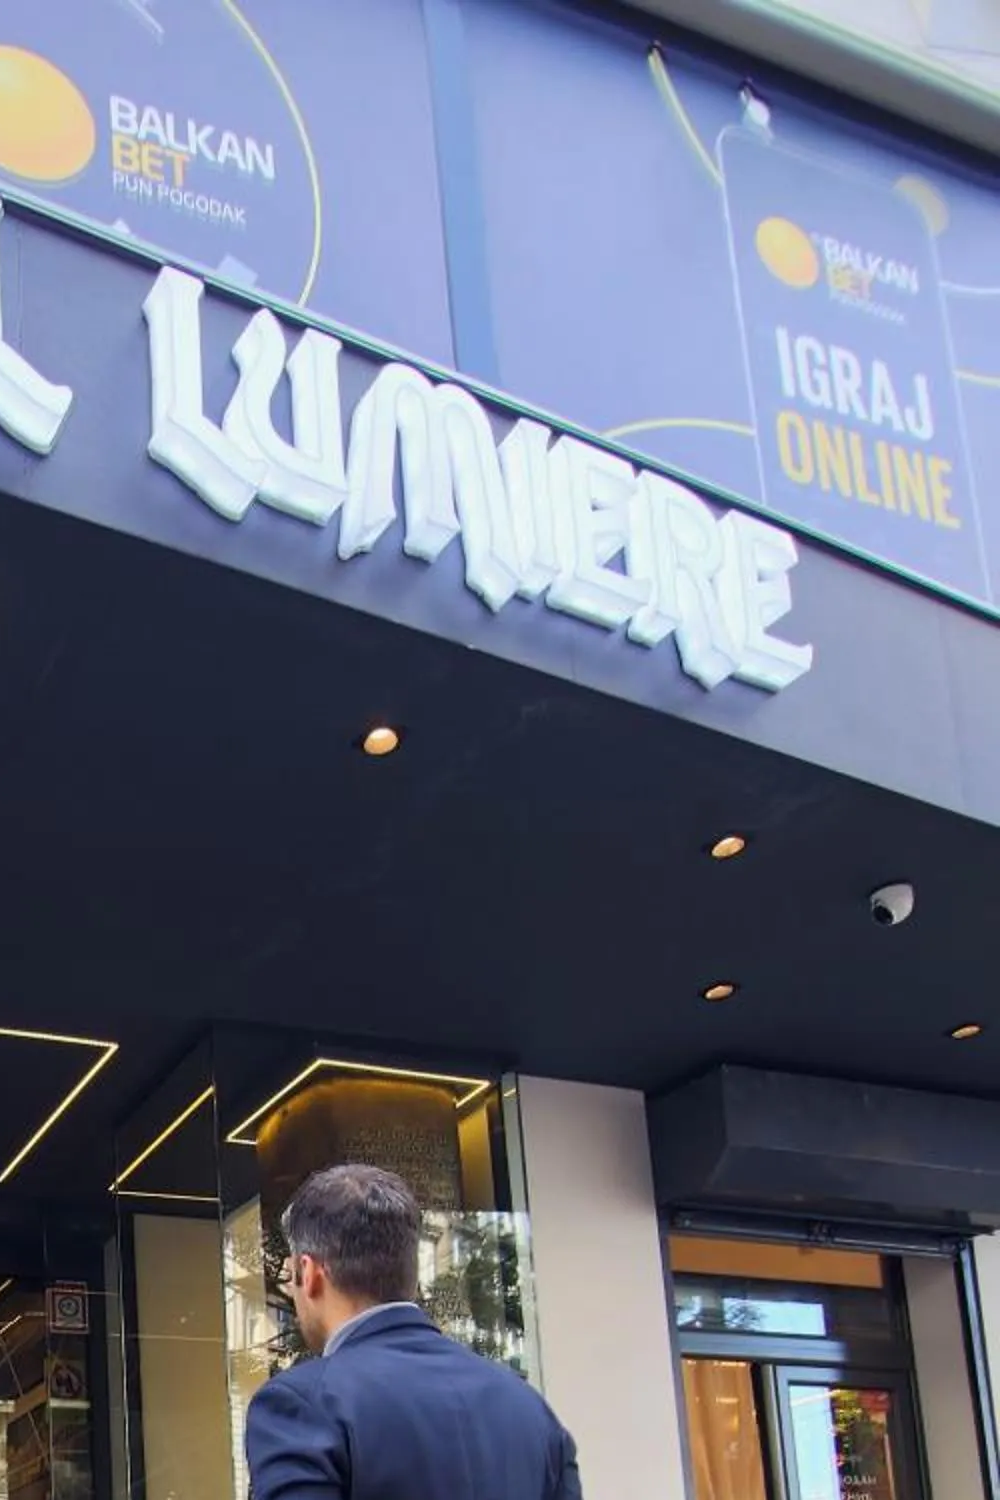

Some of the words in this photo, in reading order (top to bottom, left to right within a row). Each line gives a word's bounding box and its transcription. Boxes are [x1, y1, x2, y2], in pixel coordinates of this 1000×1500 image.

[110, 94, 276, 182] BALKAN
[112, 131, 190, 189] BET
[112, 170, 153, 197] PUN
[157, 183, 247, 226] POGODAK
[823, 236, 919, 296] BALKAN
[775, 323, 934, 442] IGRAJ
[138, 265, 813, 693] LUMIERE
[776, 408, 962, 530] ONLINE
